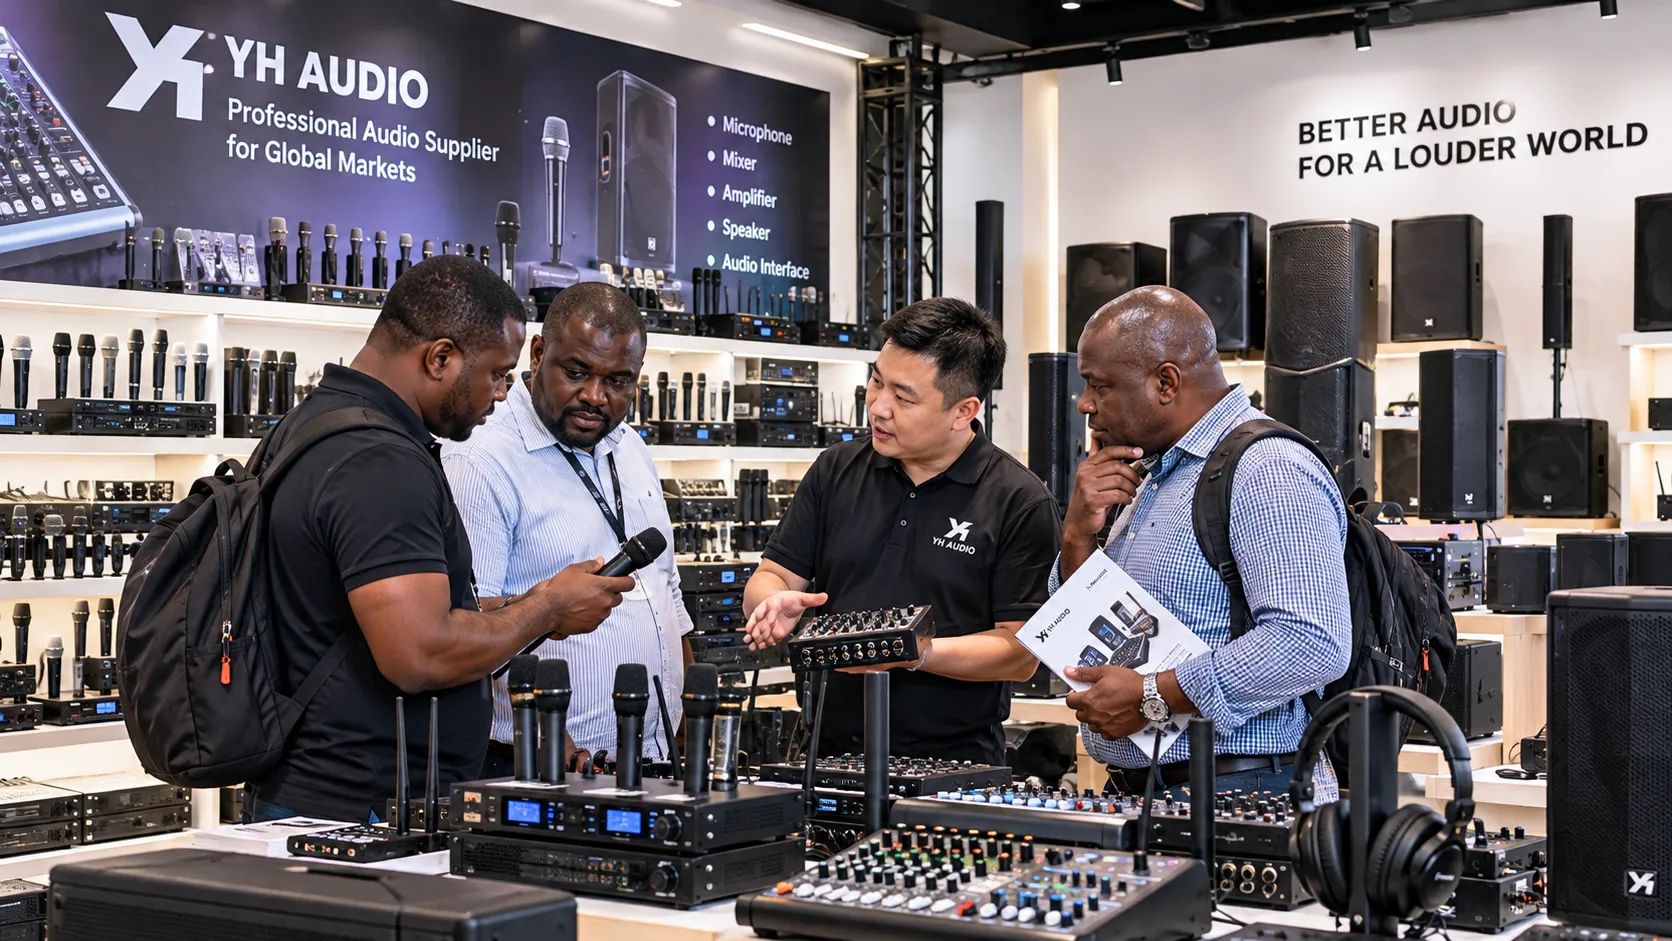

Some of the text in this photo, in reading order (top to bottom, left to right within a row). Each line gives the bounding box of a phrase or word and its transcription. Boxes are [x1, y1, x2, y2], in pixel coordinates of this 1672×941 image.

[224, 35, 429, 109] YH AUDIO
[228, 97, 500, 163] Professional Audio Supplier
[722, 115, 793, 146] Microphone
[1299, 100, 1516, 145] BETTER AUDIO
[227, 134, 416, 183] for Global Markets
[722, 149, 758, 172] Mixer
[1298, 122, 1648, 180] FOR A LOUDER WORLD
[722, 183, 778, 210] Amplifier
[722, 217, 772, 242] Speaker
[721, 252, 810, 280] Audio Interface
[932, 536, 976, 555] YH AUDIO
